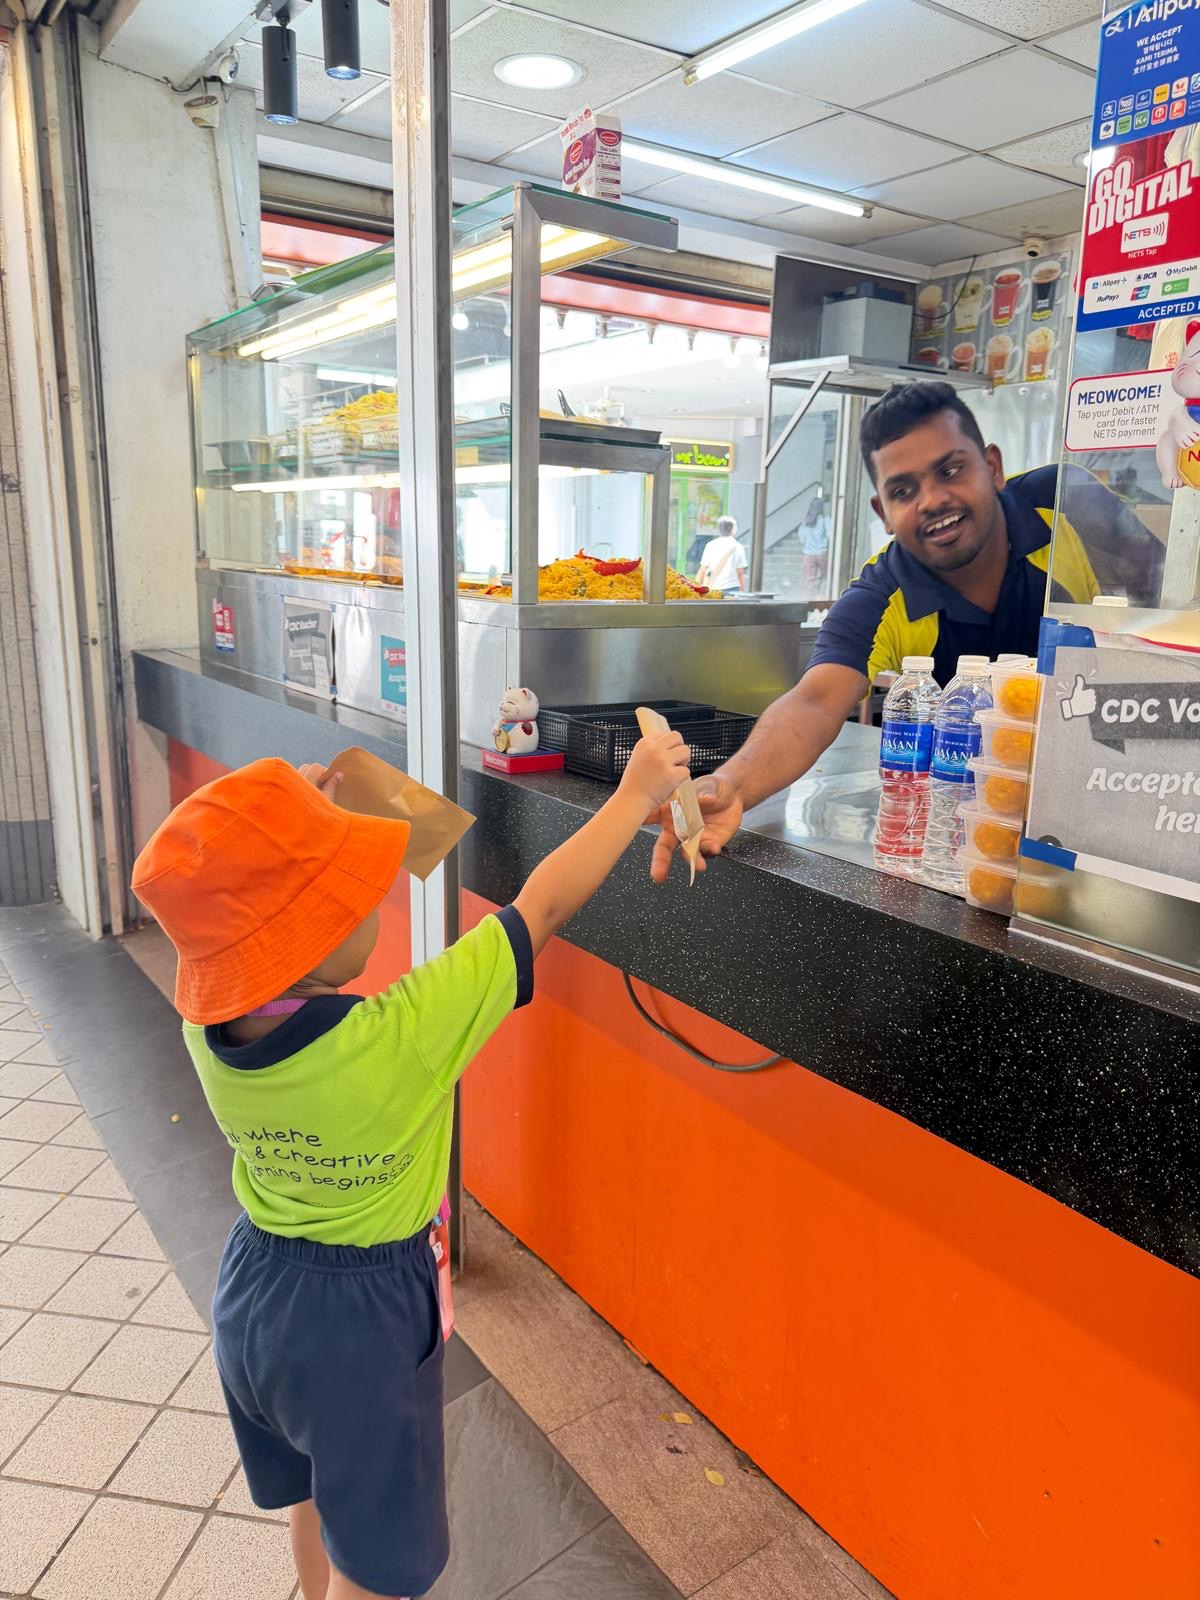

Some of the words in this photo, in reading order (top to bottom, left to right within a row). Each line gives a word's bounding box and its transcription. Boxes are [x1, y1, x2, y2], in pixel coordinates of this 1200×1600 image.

[1136, 36, 1149, 48] WE
[1150, 25, 1183, 43] ACCEPT
[1136, 54, 1153, 65] KAMI
[1154, 46, 1178, 60] TERIMA
[1094, 160, 1132, 202] GO
[1087, 162, 1193, 236] DIGITAL
[1123, 227, 1151, 242] NETS
[1128, 250, 1145, 259] NETS
[1145, 248, 1157, 257] Tap
[1172, 265, 1198, 275] MyDebit
[1138, 302, 1195, 319] ACCEPTED
[1077, 385, 1161, 405] MEOWCOME!
[1078, 410, 1091, 420] Tap
[1092, 409, 1110, 420] your
[1112, 406, 1134, 416] Debit
[1141, 404, 1160, 414] ATM
[1096, 418, 1115, 428] card
[1117, 417, 1129, 427] for
[1130, 416, 1157, 426] faster
[1093, 429, 1117, 439] NETS
[1118, 427, 1155, 439] payment
[1101, 698, 1161, 724] CDC
[882, 738, 918, 751] DASANI
[244, 1127, 322, 1147] where
[255, 1146, 265, 1159] &
[273, 1148, 396, 1169] creative
[309, 1172, 388, 1191] begins
